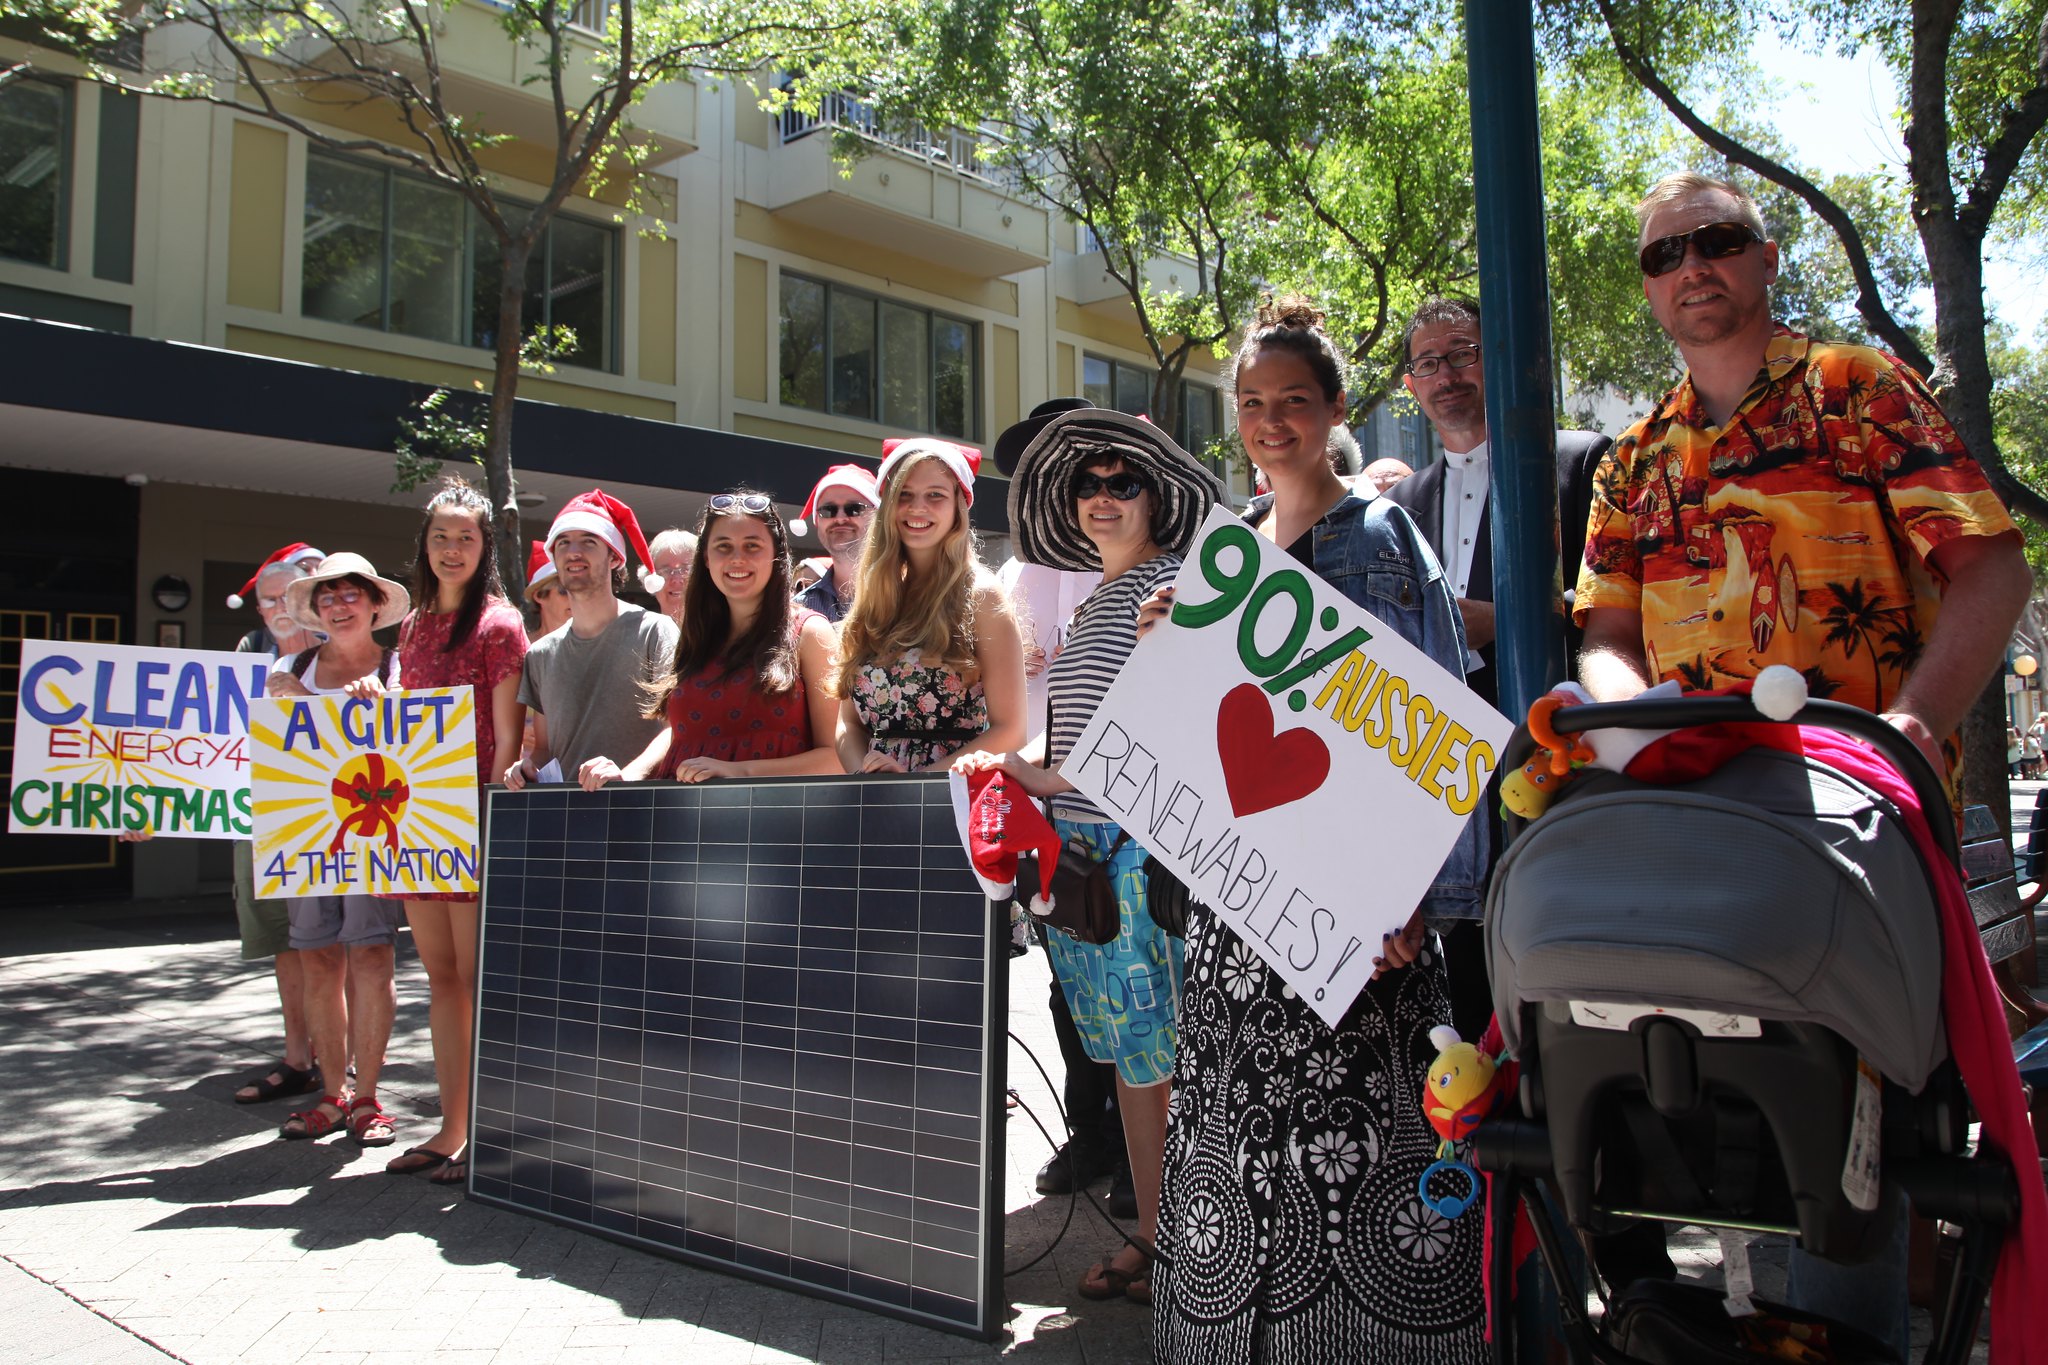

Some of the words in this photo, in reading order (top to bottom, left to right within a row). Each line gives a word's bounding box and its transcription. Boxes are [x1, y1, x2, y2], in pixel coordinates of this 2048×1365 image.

[21, 655, 268, 735] CLEAN
[1170, 525, 1373, 712] 90%
[1312, 649, 1496, 816] AUSSIES
[283, 701, 321, 751] A
[341, 696, 454, 750] GIFT
[11, 780, 253, 836] CHRISTMAS
[264, 851, 297, 887] 4
[299, 850, 358, 885] THE
[369, 845, 477, 883] NATION
[1078, 720, 1362, 1002] RENEWABLES!
